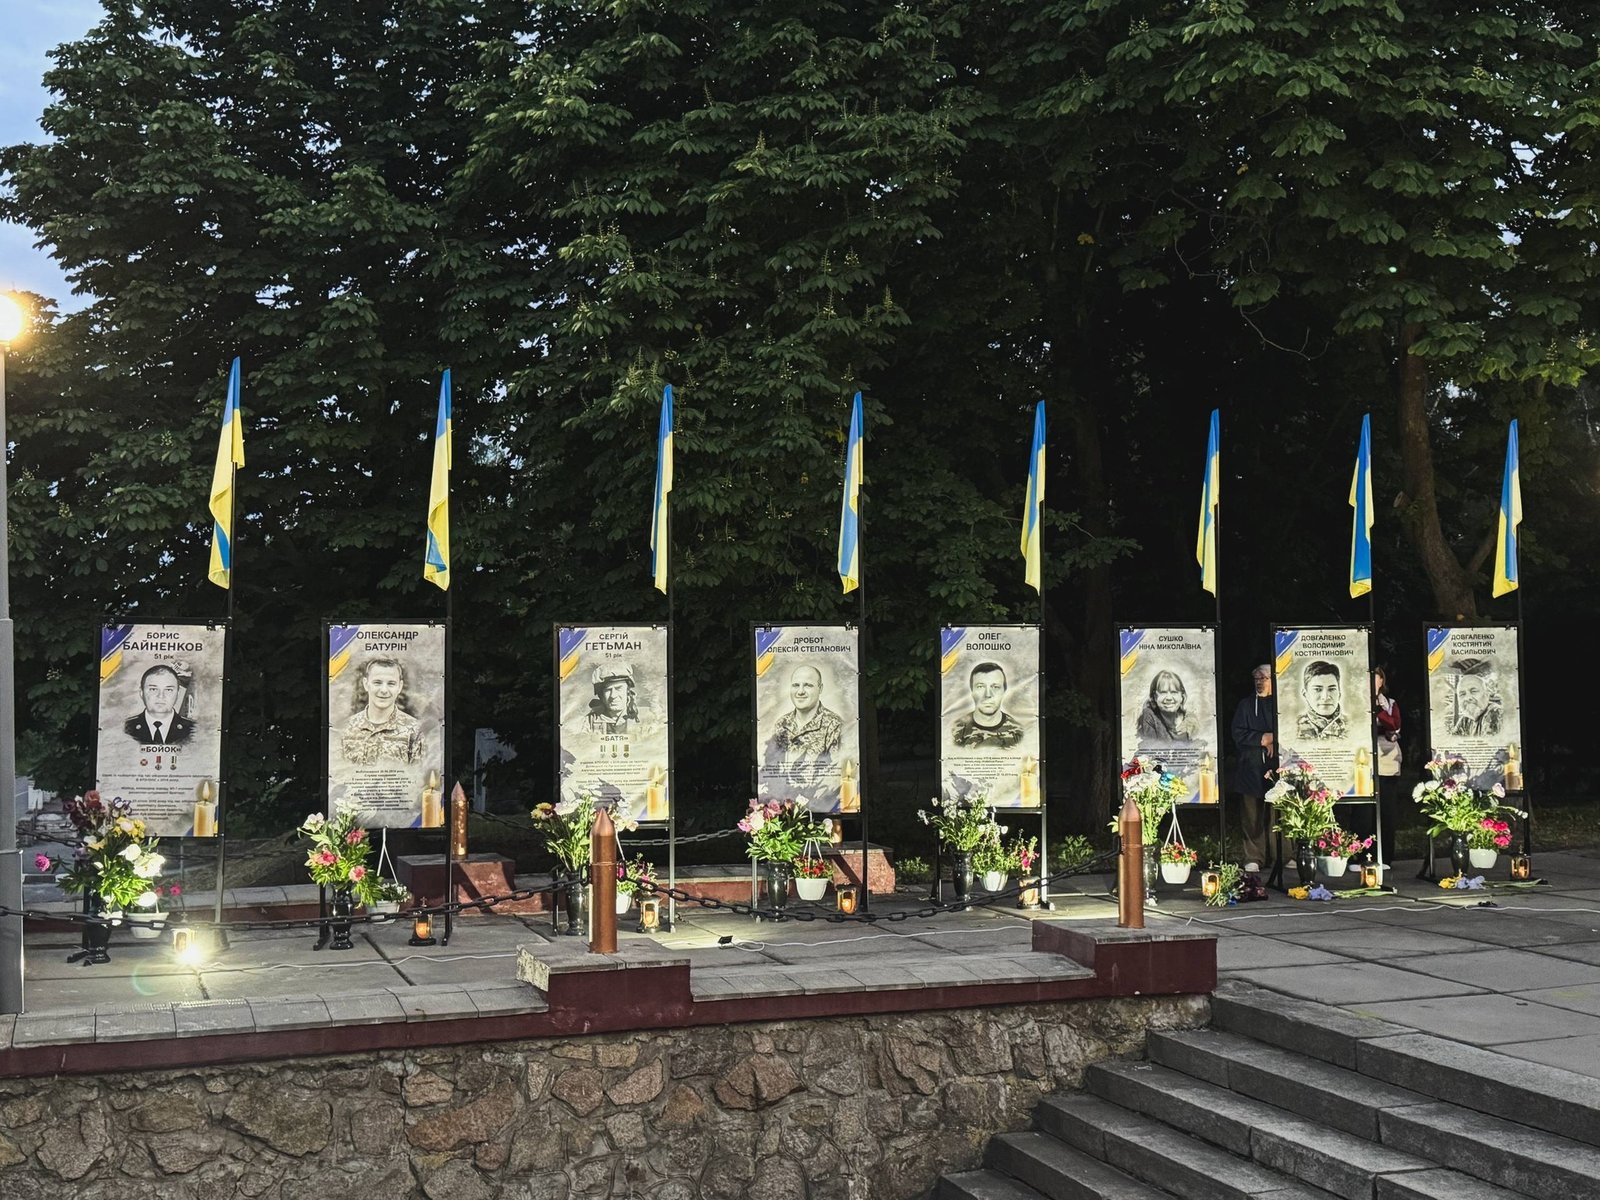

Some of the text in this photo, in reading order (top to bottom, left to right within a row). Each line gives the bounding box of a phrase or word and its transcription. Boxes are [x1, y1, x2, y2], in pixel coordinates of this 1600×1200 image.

[146, 632, 180, 640] БОРИС
[356, 631, 418, 640] ОЛЕКСАНДР
[599, 632, 628, 640] СЕРГІЙ
[123, 640, 203, 652] БАЙНЕНКОВ
[364, 643, 408, 651] БАТУРІН
[586, 642, 642, 651] ГЕТЬМАН
